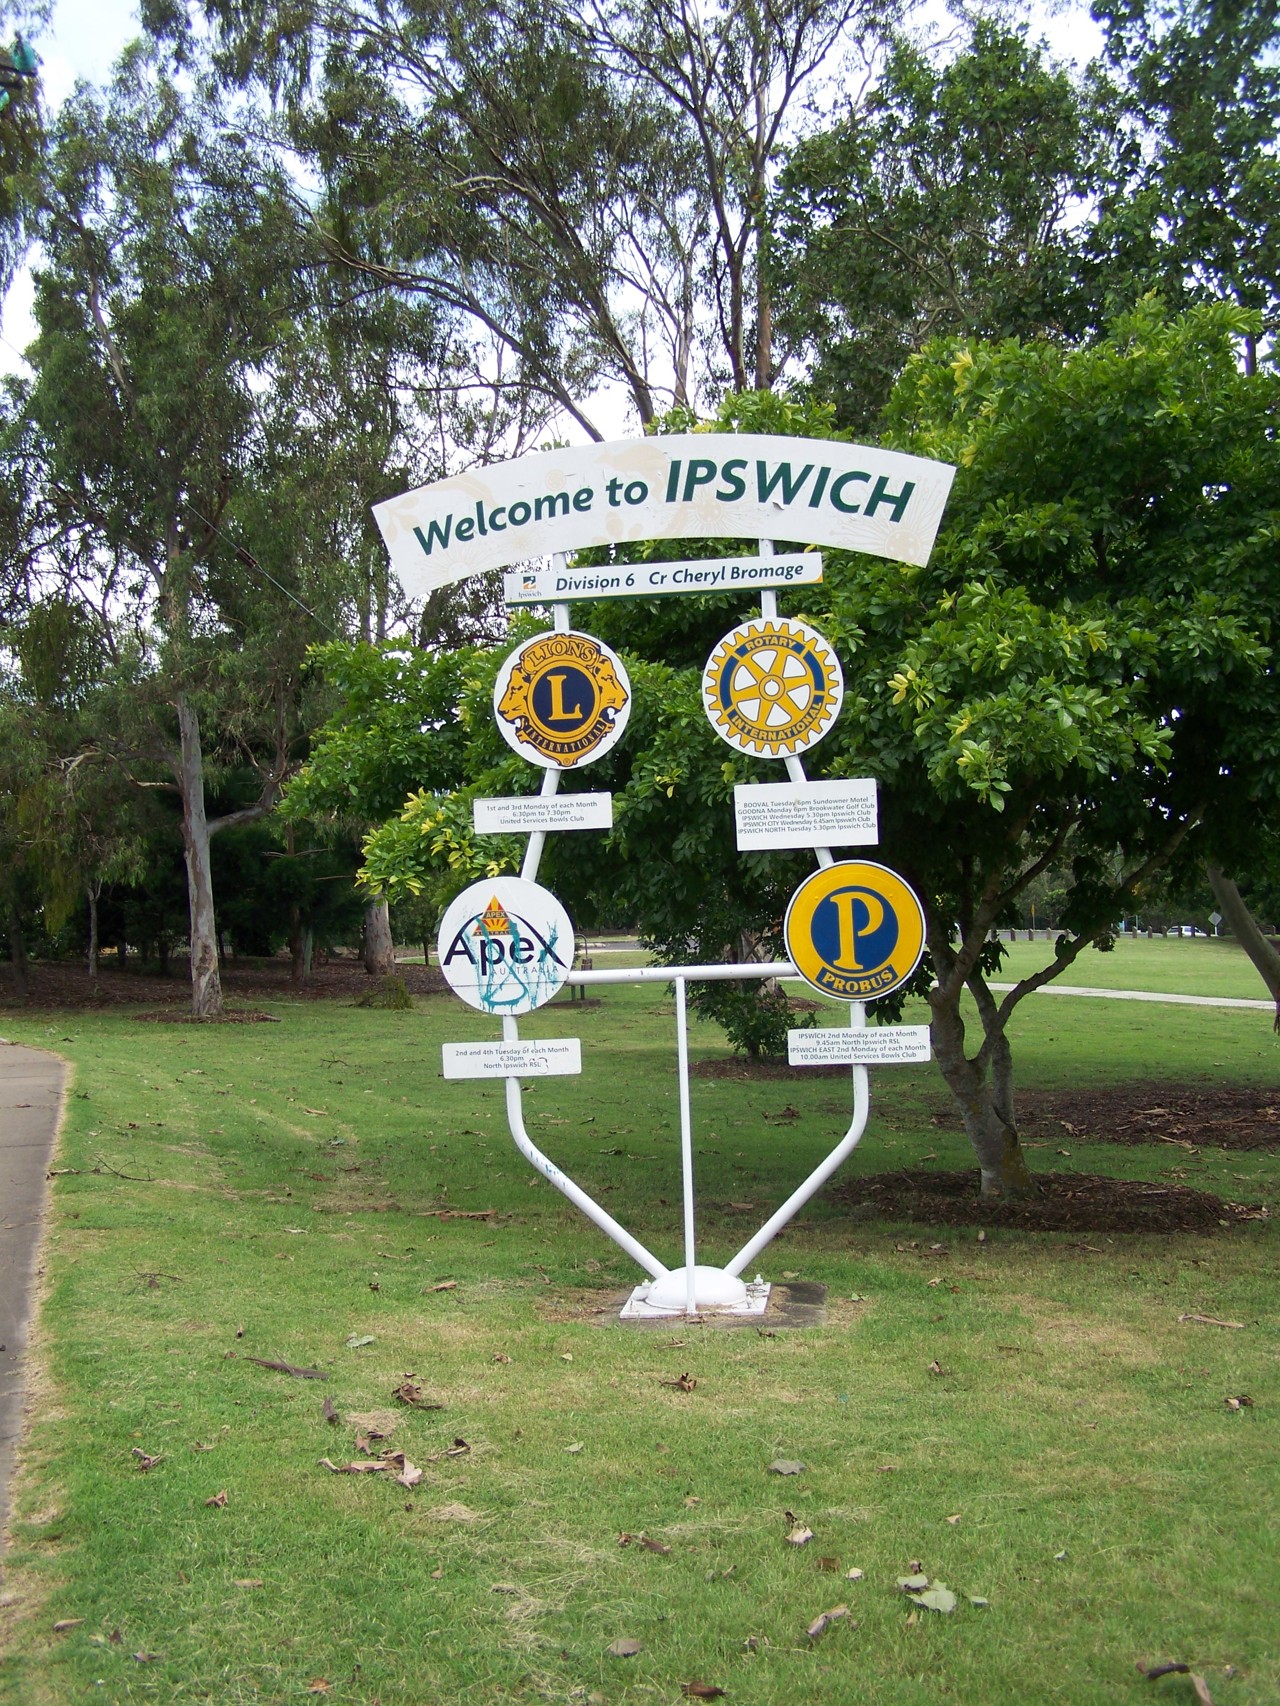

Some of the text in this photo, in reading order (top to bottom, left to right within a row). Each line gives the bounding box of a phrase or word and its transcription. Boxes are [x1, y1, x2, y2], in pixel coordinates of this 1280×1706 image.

[413, 459, 916, 555] Welcome to IPSWICH
[556, 563, 803, 592] Division 6 Cr Cheryl Bromage
[518, 591, 542, 599] Ipswich
[527, 641, 597, 667] LIONS
[746, 636, 797, 651] ROTARY
[547, 675, 583, 720] L
[731, 702, 822, 741] INTERNATIONAL
[525, 723, 605, 753] INTERNATIONAL
[809, 804, 844, 812] Brookwater
[443, 912, 568, 976] Apex
[830, 891, 884, 970] P
[822, 970, 893, 992] PROBUS
